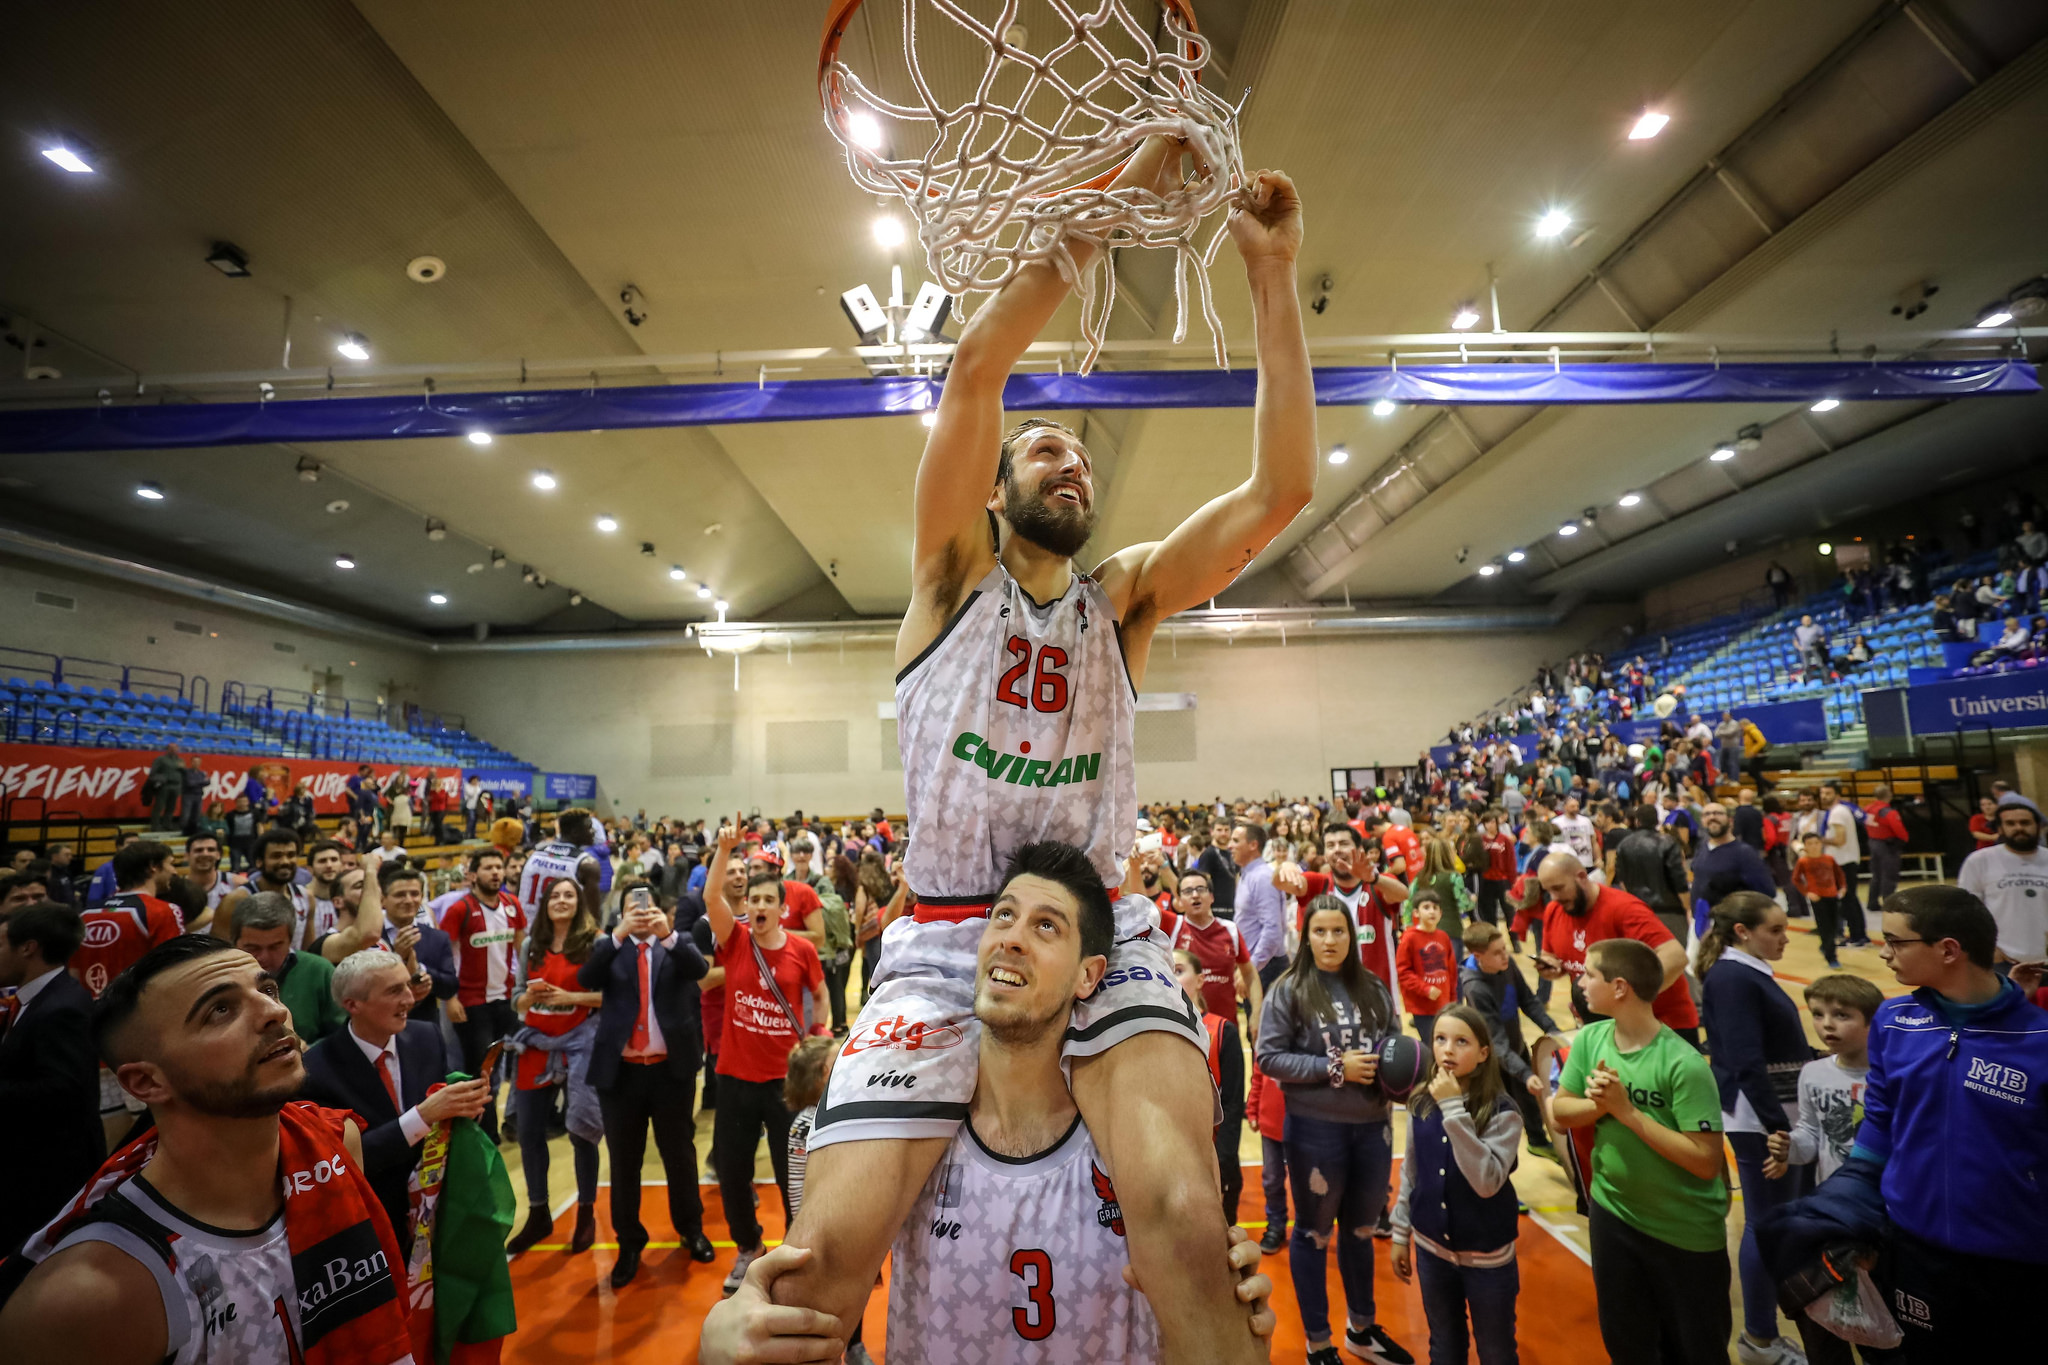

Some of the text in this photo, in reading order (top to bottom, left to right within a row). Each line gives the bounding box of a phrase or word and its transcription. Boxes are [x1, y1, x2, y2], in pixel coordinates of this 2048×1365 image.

[997, 634, 1068, 713] 26
[1950, 690, 2048, 717] Universi
[952, 731, 1101, 788] COVIRAN
[0, 763, 141, 801] EFIENDE
[86, 926, 112, 941] KIA
[869, 1015, 923, 1051] stg
[1894, 1014, 1934, 1026] uhlsport
[866, 1069, 918, 1088] vive
[1963, 1079, 2026, 1105] MUTILBASKET
[1967, 1057, 2028, 1093] MB
[1099, 1208, 1121, 1221] GRAN
[299, 1249, 389, 1316] xaBan
[1010, 1249, 1056, 1341] 3
